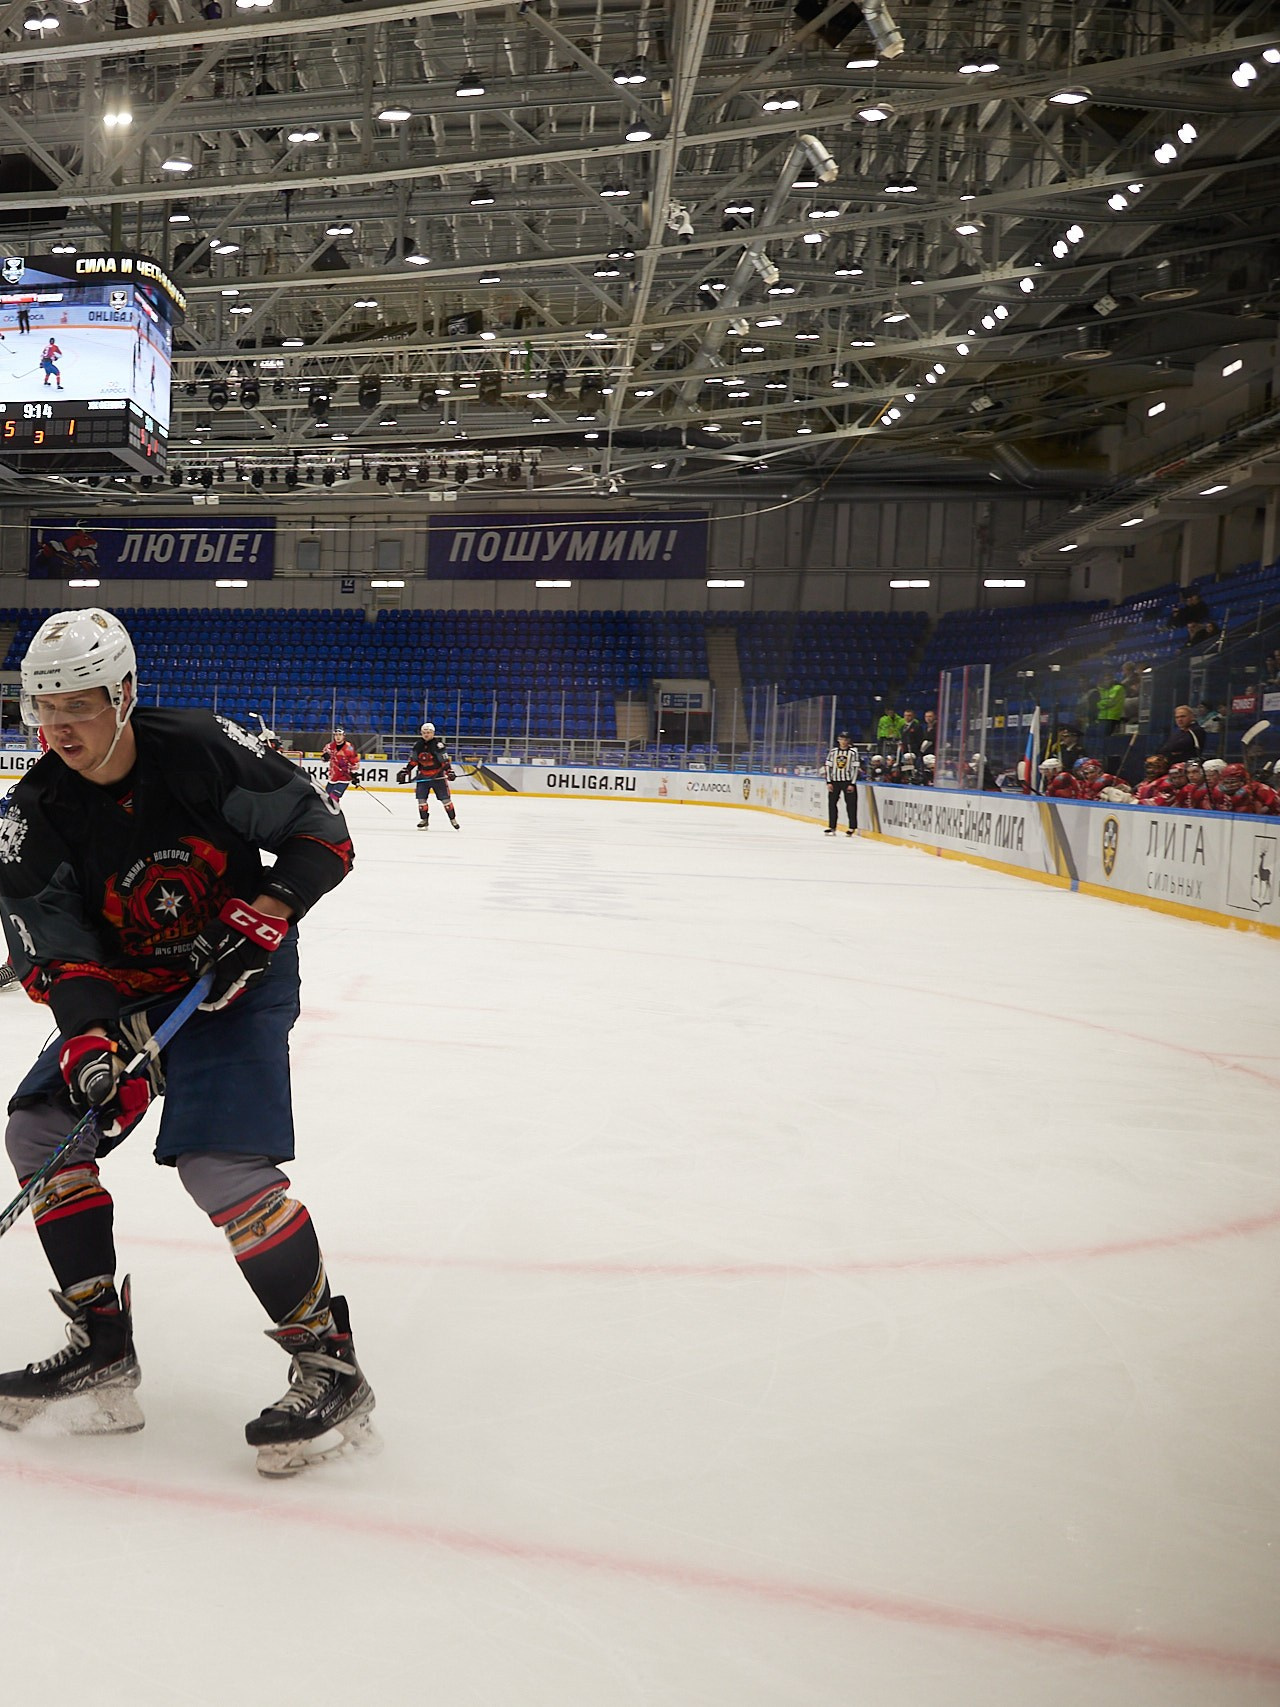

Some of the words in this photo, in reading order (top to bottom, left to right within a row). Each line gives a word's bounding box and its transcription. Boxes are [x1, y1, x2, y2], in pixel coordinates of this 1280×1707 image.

[76, 258, 117, 274] СИЛА
[121, 258, 133, 274] И
[23, 403, 53, 419] 9:14
[4, 421, 16, 437] 5
[68, 419, 75, 435] 1
[33, 431, 44, 444] 3
[116, 533, 263, 564] ЛЮТЫЕ!
[448, 530, 679, 562] ПОШУМИМ!
[546, 773, 637, 792] OHLIGA.RU
[700, 783, 732, 794] АЛРОСА
[882, 799, 934, 833] ОФИЦЕРСКАЯ
[934, 799, 992, 846] ХОККЕЙНАЯ
[994, 813, 1025, 852] ЛИГА
[1146, 820, 1206, 866] ЛИГА
[121, 858, 146, 888] НИЖНИЙ
[153, 849, 191, 863] НОВГОРОД
[1147, 871, 1203, 900] СИЛЬНЫХ
[155, 947, 172, 956] МЧС
